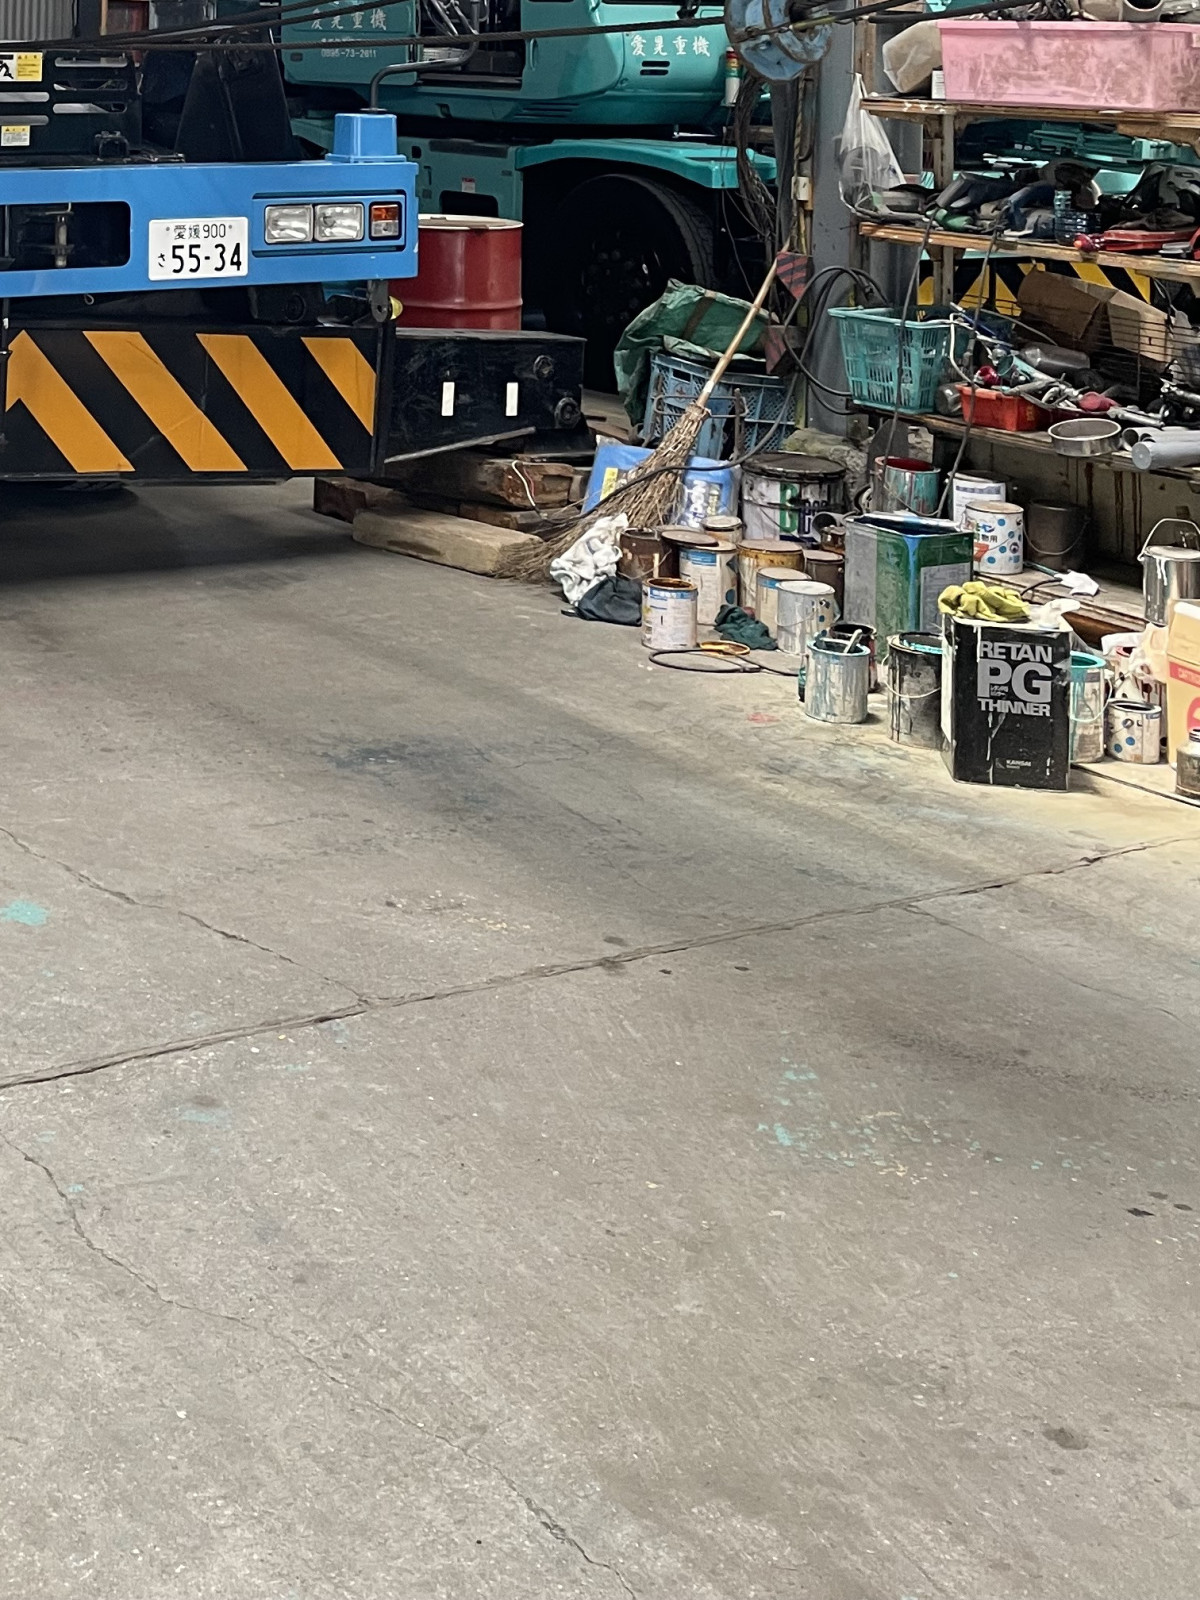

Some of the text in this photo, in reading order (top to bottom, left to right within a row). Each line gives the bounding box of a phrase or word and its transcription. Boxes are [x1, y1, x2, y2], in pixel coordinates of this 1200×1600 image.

[171, 242, 242, 274] 55-34
[979, 641, 1053, 663] RETAN
[977, 659, 1052, 703] PG
[978, 698, 1051, 717] THINNER
